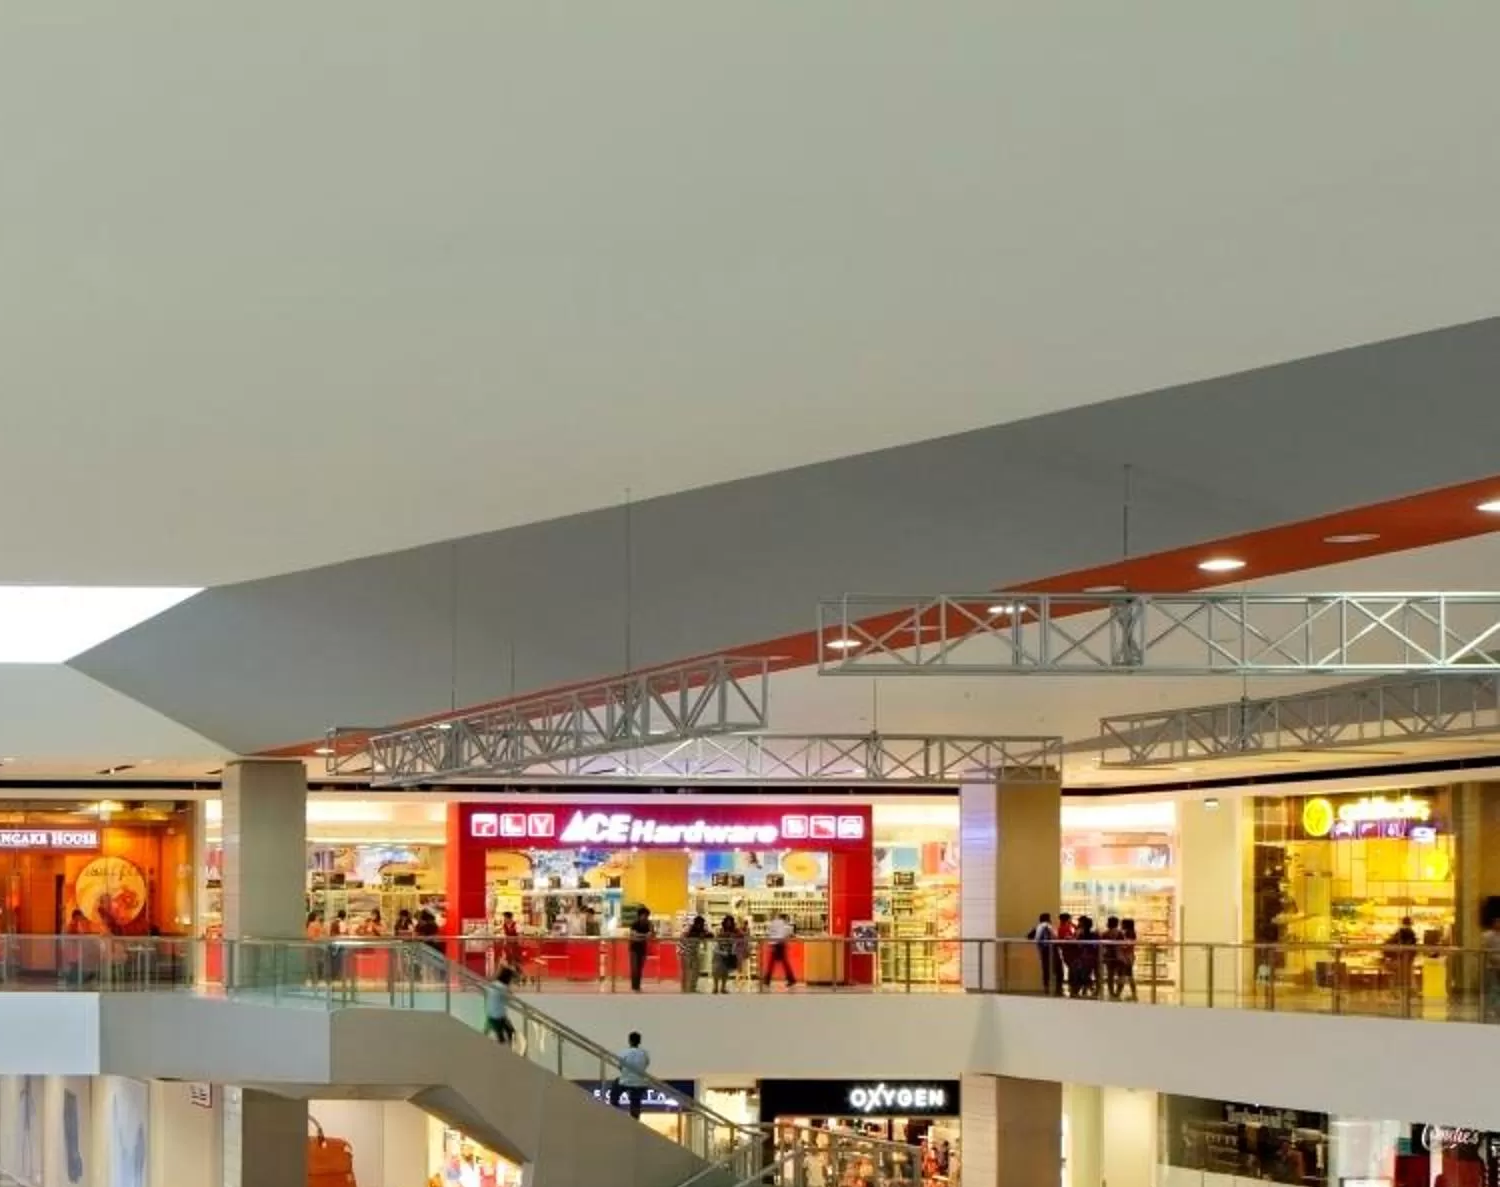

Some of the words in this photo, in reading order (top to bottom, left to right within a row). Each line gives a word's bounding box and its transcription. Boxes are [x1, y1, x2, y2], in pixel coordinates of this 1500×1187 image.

[559, 810, 631, 842] ACE
[630, 820, 778, 843] Hardware
[850, 1083, 945, 1112] OXYGEN
